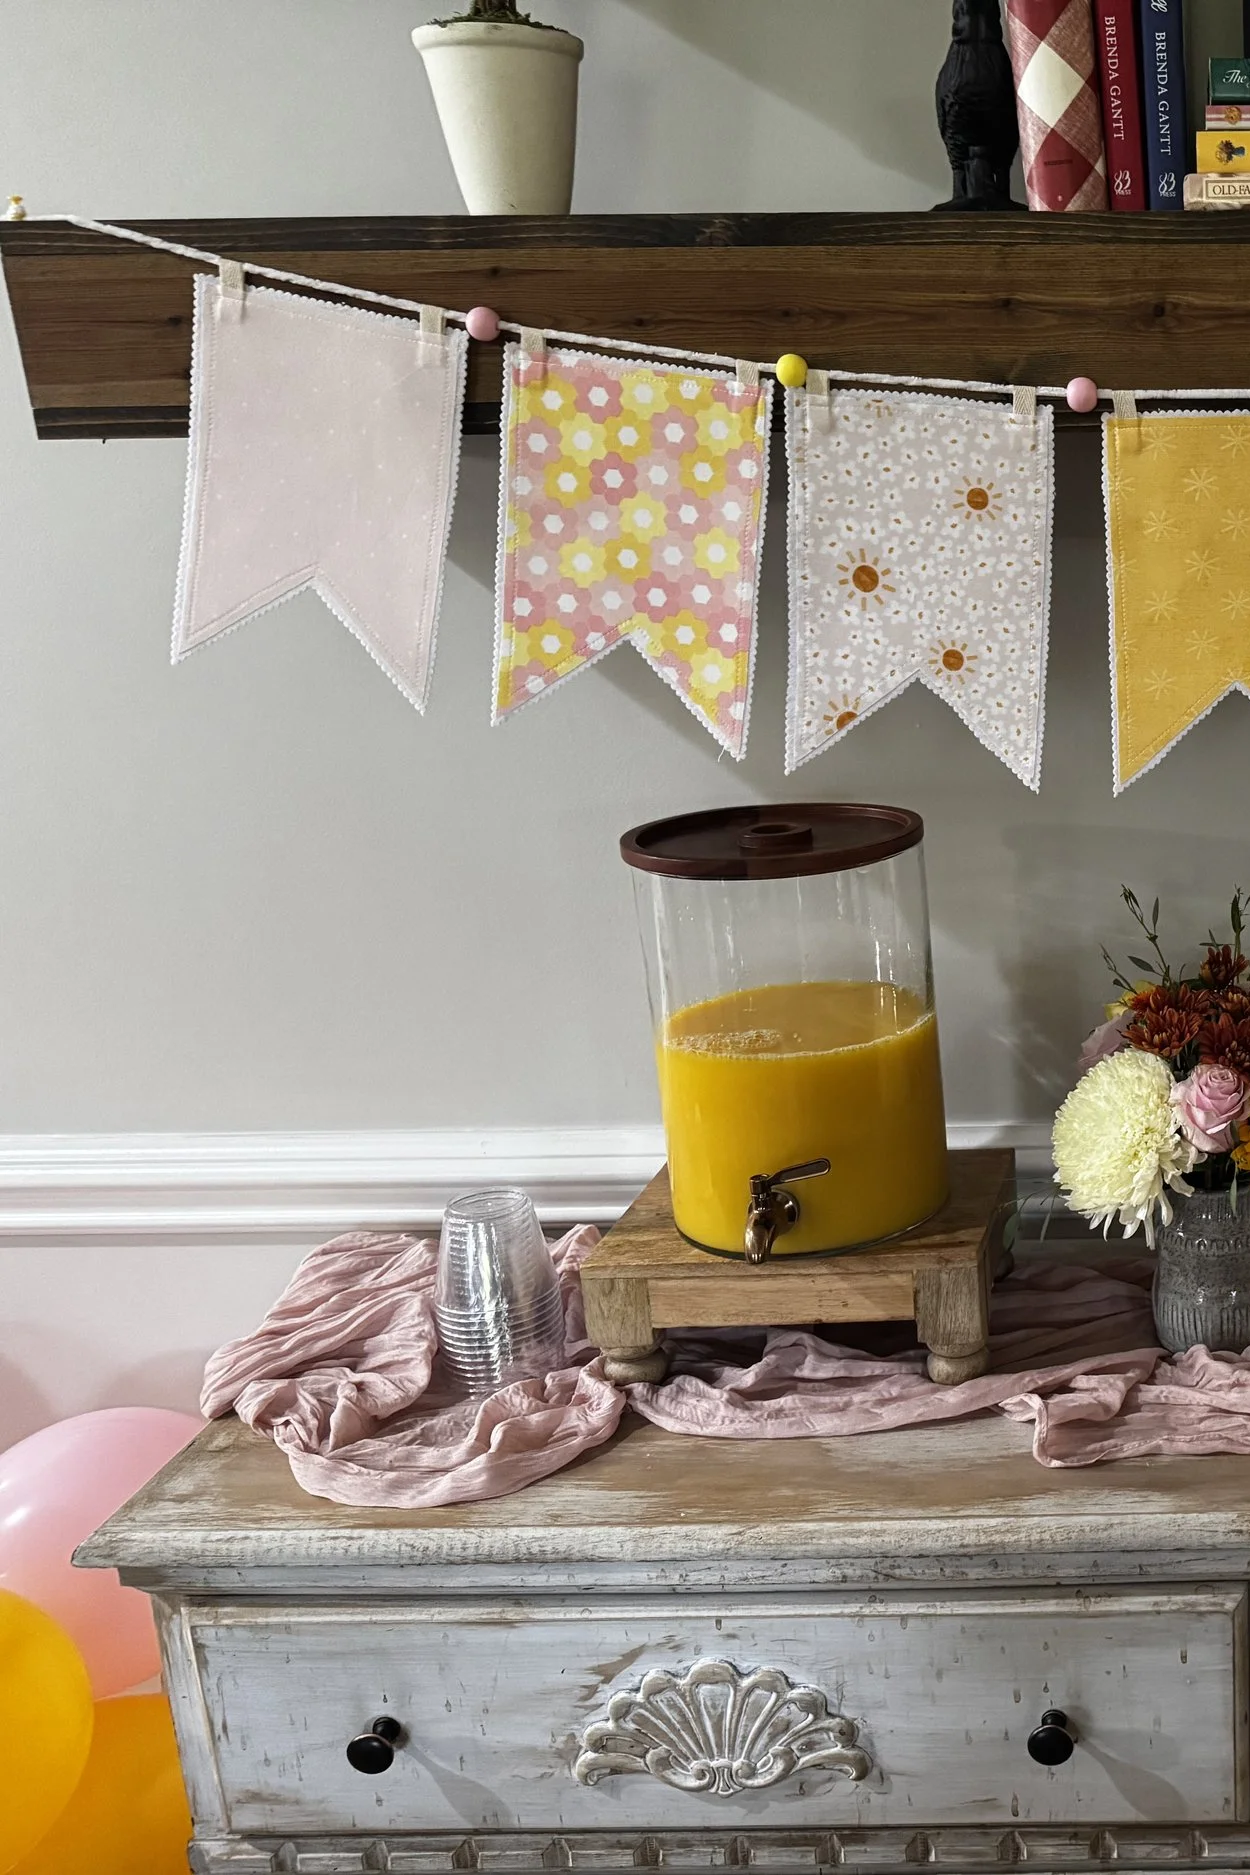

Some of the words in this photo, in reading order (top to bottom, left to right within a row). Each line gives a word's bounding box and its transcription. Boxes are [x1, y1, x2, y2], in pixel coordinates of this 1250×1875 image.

[1104, 16, 1119, 80] BRENDA
[1155, 32, 1168, 95] BRENDA
[1222, 69, 1247, 84] The
[1109, 85, 1124, 140] GANTT
[1158, 101, 1171, 155] GANTT
